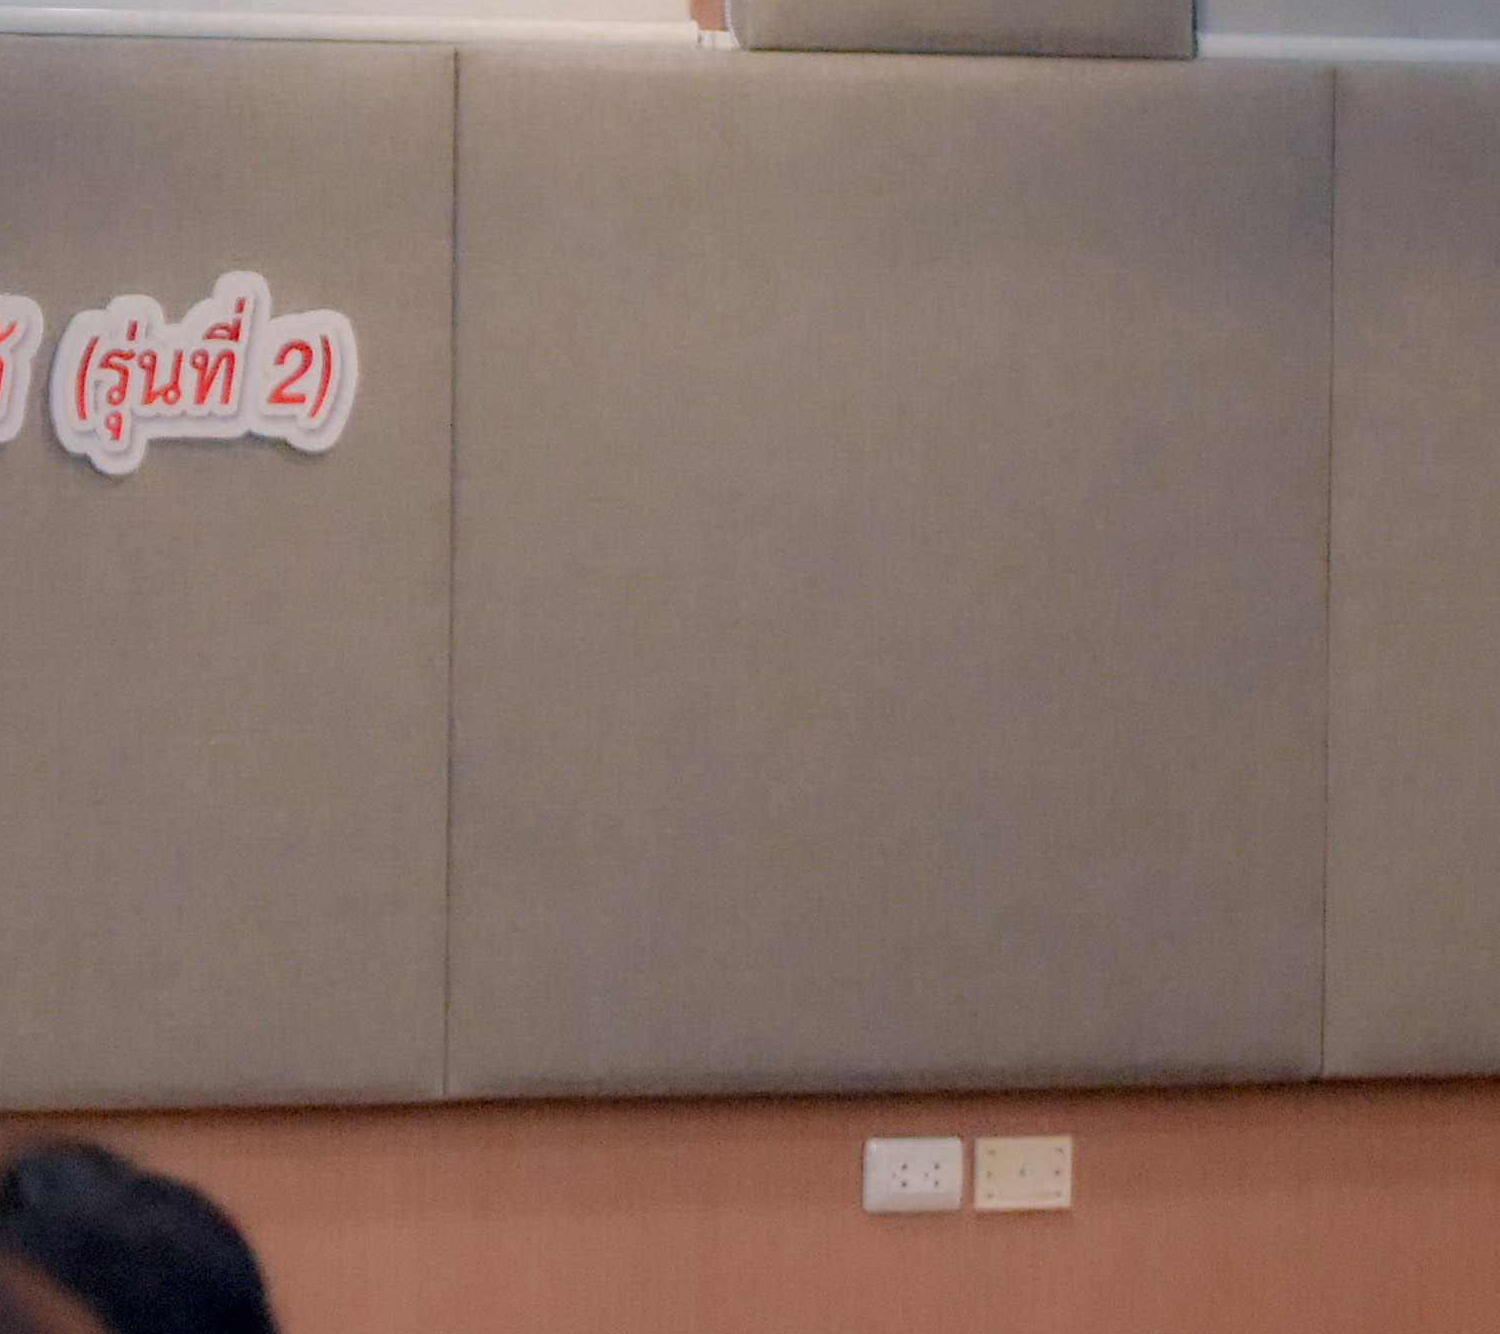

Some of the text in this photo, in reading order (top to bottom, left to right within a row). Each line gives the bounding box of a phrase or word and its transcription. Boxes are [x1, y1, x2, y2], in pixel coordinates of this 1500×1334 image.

[74, 297, 245, 442] (รุ่นที่
[266, 335, 334, 419] 2)
